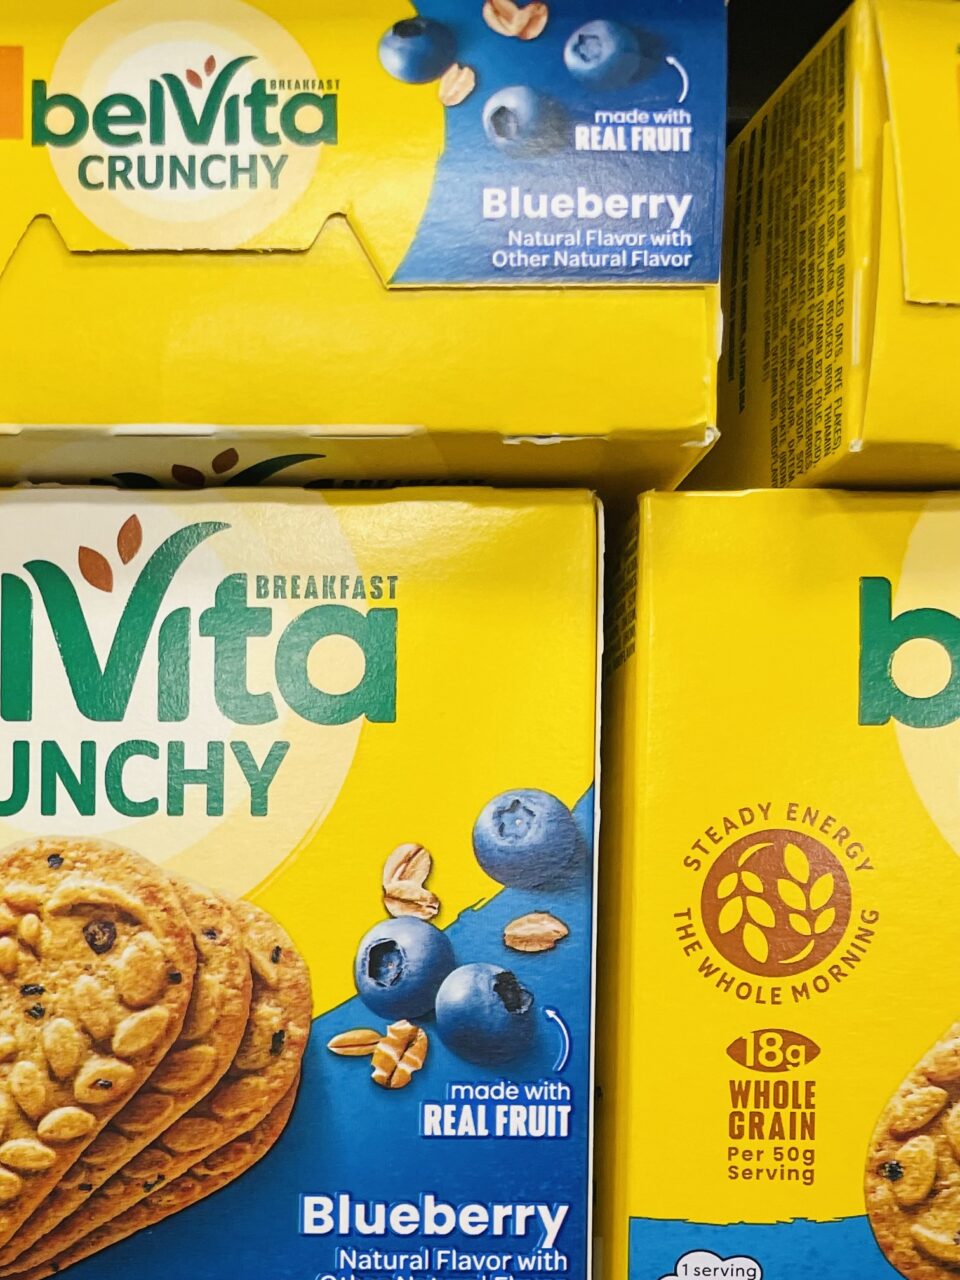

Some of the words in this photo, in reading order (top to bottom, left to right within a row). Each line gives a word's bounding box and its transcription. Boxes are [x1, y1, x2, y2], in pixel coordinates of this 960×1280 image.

[270, 78, 341, 91] BREAKFAST
[31, 56, 339, 147] belVita
[594, 109, 648, 125] made
[652, 109, 692, 125] with
[575, 126, 627, 151] REAL
[631, 126, 692, 151] FRUIT
[78, 155, 289, 191] CRUNCHY
[482, 187, 692, 230] Blueberry
[255, 575, 398, 600] BREAKFAST
[451, 1081, 519, 1101] made
[524, 1081, 570, 1101] with
[729, 1080, 816, 1110] WHOLE
[423, 1104, 490, 1139] REAL
[496, 1104, 571, 1138] FRUIT
[728, 1110, 816, 1141] GRAIN
[302, 1194, 569, 1249] Blueberry
[339, 1250, 429, 1271] Natural
[437, 1250, 512, 1271] Flavor
[517, 1250, 568, 1271] with
